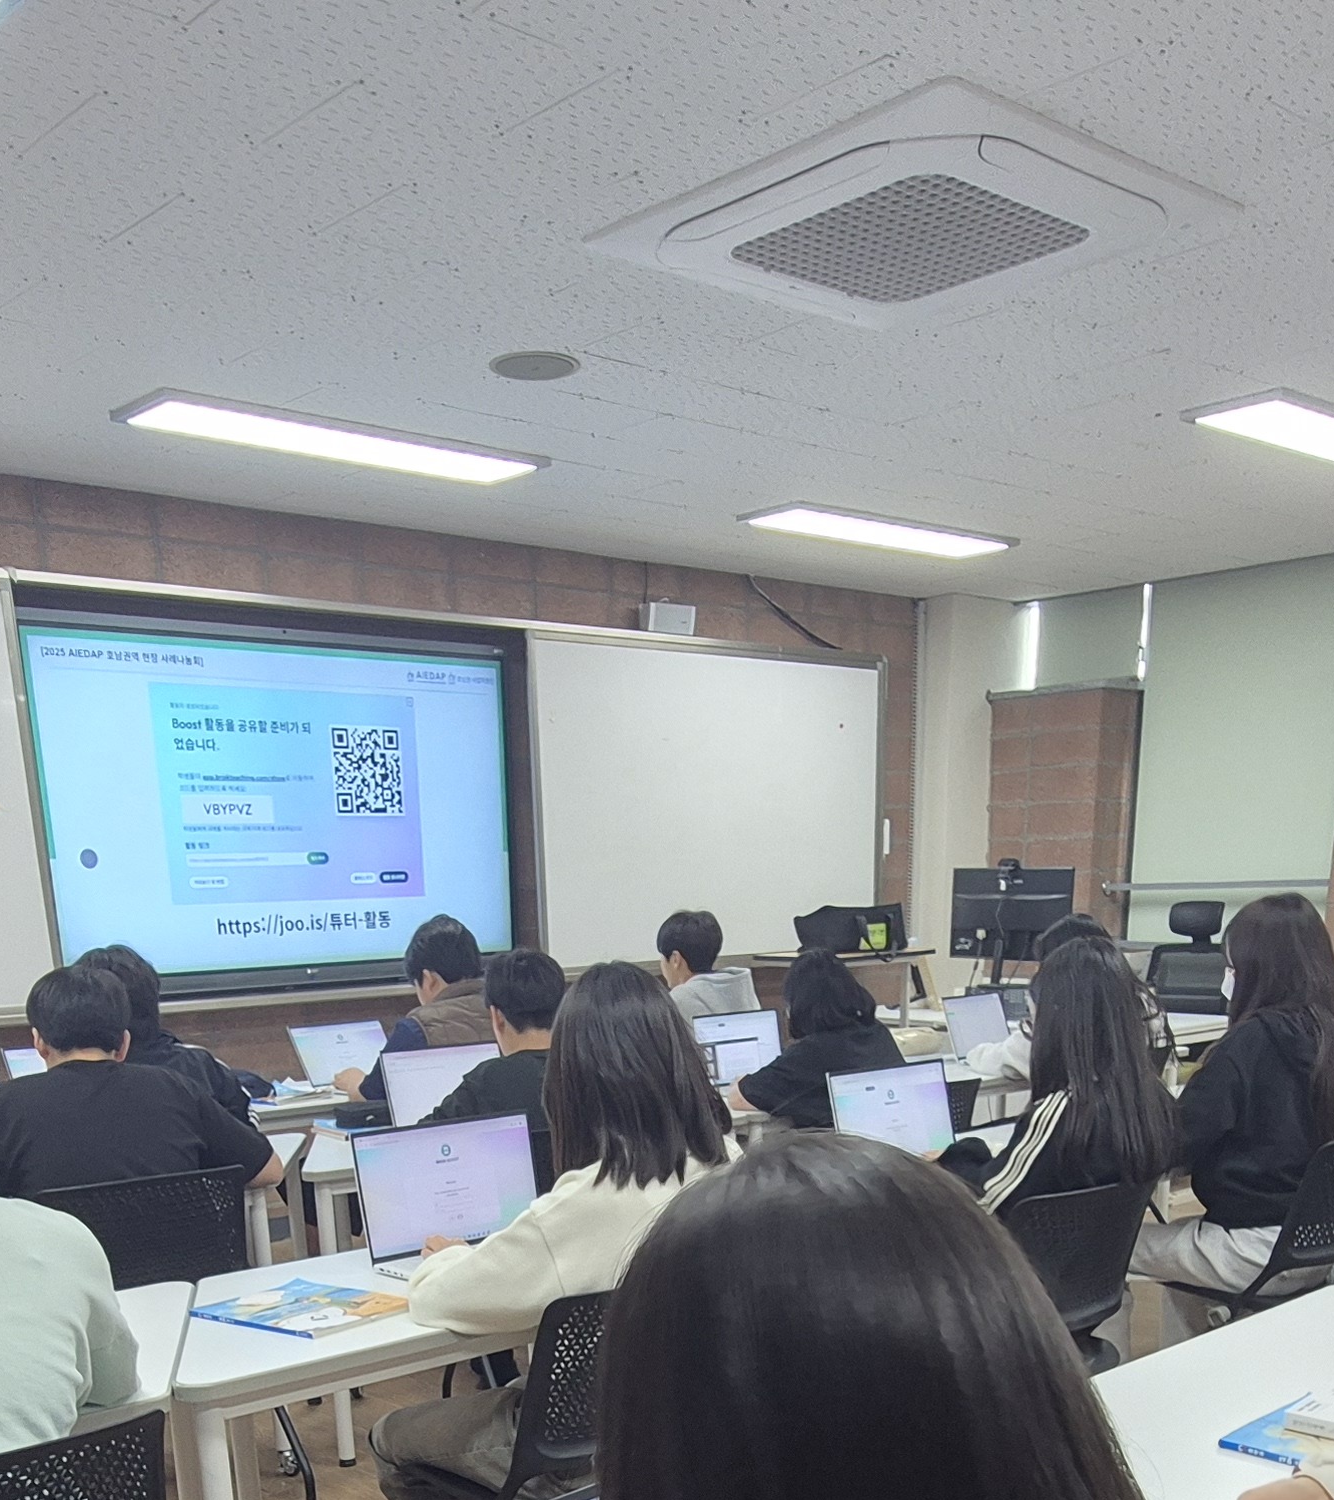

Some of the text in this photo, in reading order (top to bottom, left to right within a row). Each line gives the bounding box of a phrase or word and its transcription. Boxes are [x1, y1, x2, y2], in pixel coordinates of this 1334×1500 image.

[40, 646, 66, 657] [2025
[68, 648, 104, 659] AIEDAP
[106, 650, 140, 662] 호남권역
[415, 671, 446, 681] AIEDAP
[171, 717, 311, 734] Boost 활동을 공유할 준비가 되
[173, 737, 220, 751] 었습니다.
[217, 911, 391, 938] https://joo.is/튜터-활동
